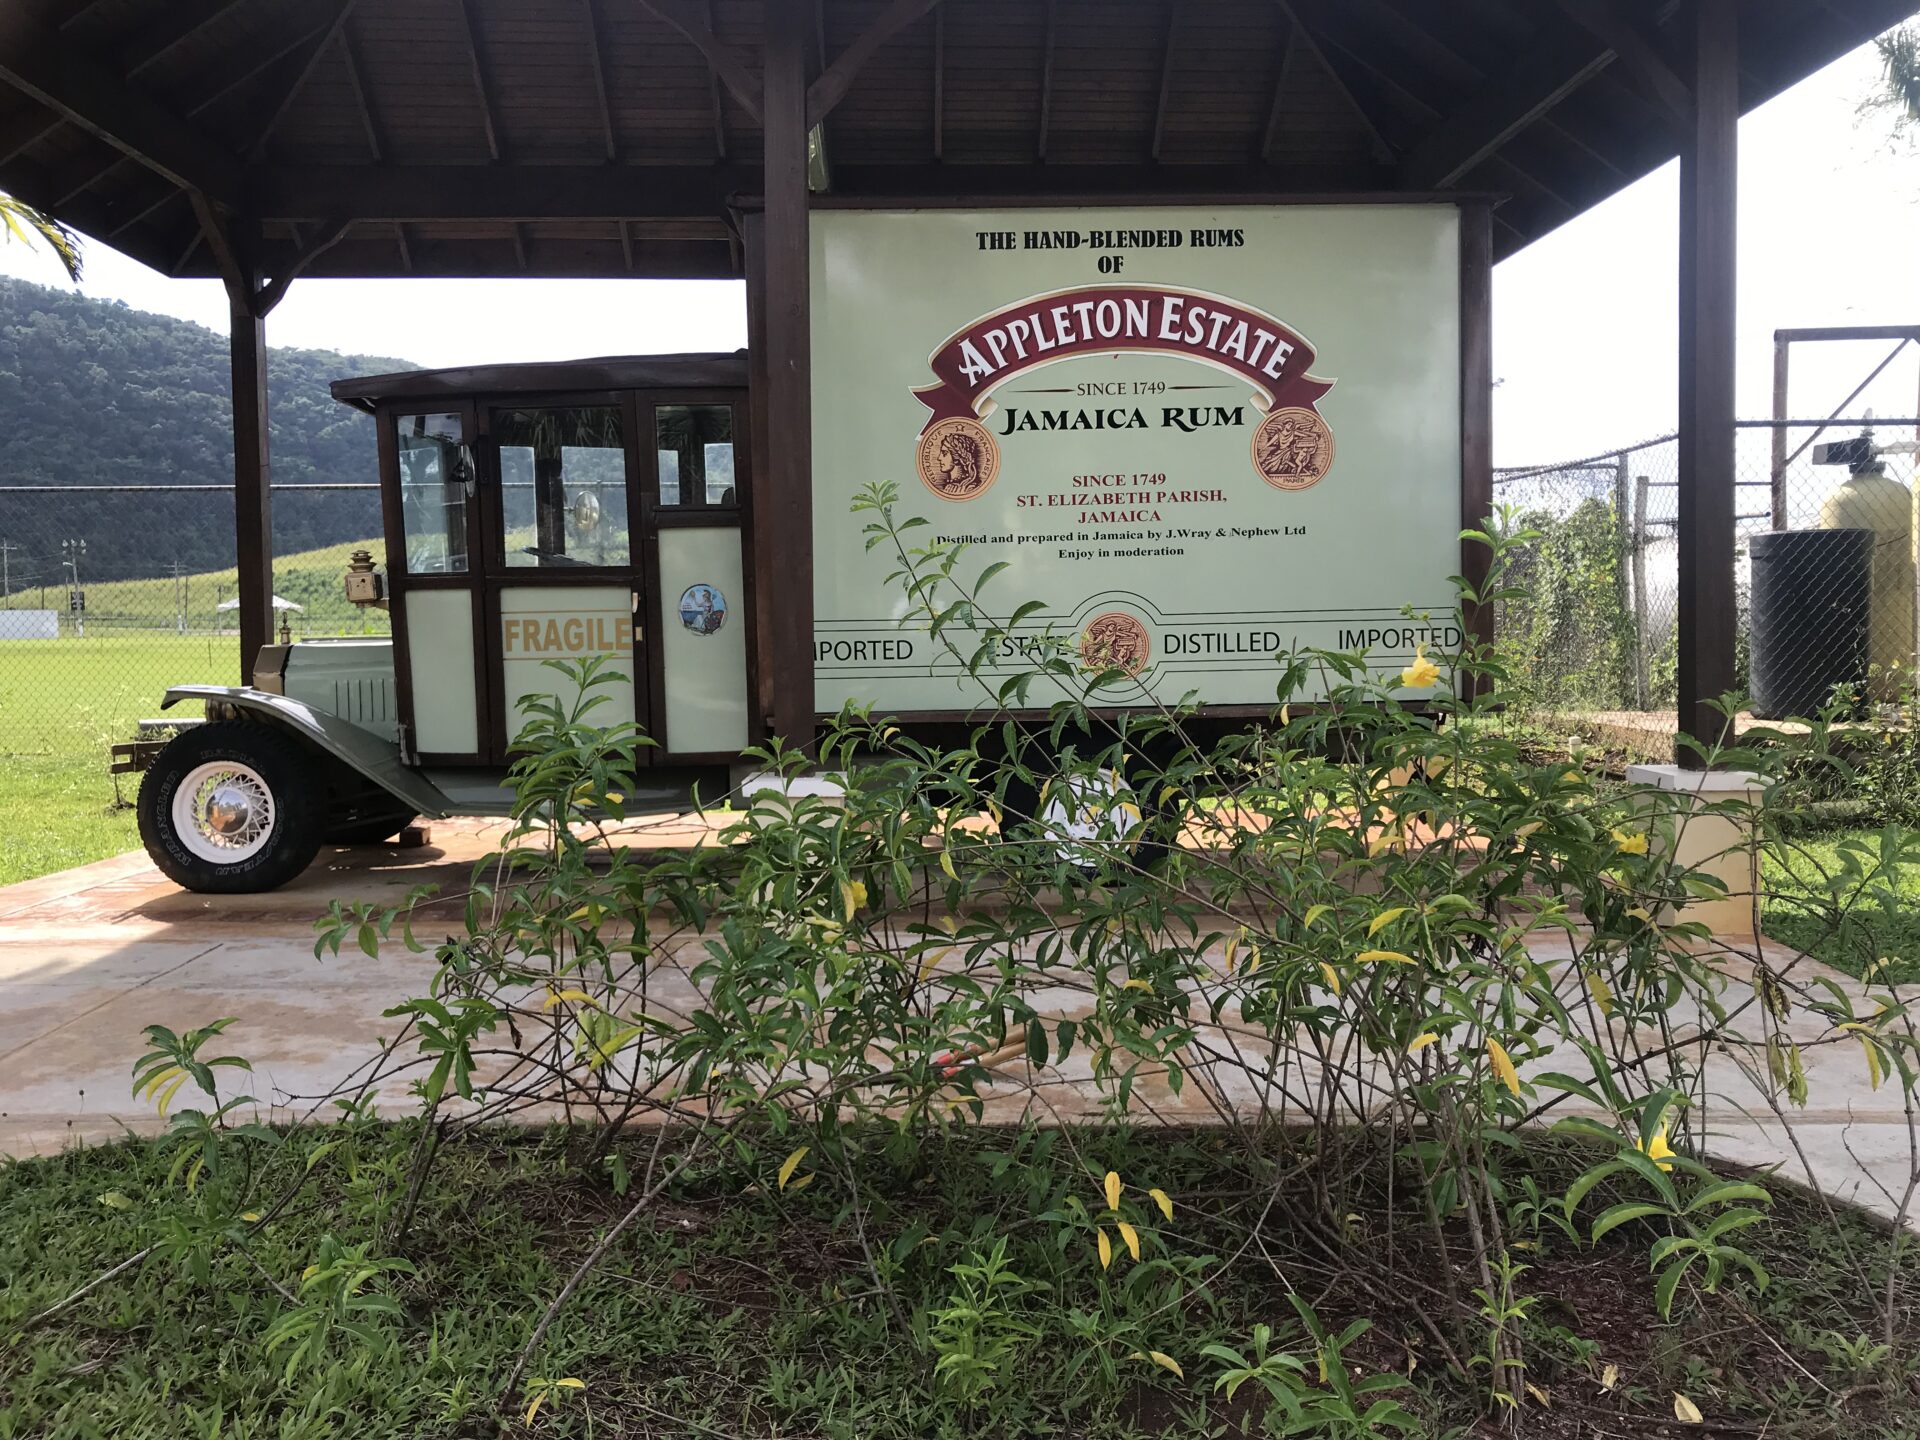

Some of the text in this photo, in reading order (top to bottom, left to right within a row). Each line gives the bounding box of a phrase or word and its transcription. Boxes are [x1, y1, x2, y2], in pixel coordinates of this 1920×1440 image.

[976, 229, 1245, 250] THE HAND-BLENDED RUMS
[1097, 256, 1124, 274] OF
[958, 296, 1295, 388] APPLETON ESTATE
[1077, 381, 1166, 396] SINCE 1749
[998, 406, 1245, 436] JAMAICA RUM
[1072, 473, 1166, 488] SINCE 1749
[1016, 489, 1228, 507] ST. ELIZABETH PARISH,
[1078, 510, 1163, 524] JAMAICA
[936, 535, 988, 545] Distilled
[990, 534, 1014, 544] and
[1017, 532, 1074, 545] prepared
[1077, 532, 1089, 541] in
[1092, 530, 1144, 541] Jamaica
[1147, 530, 1162, 541] by
[1215, 527, 1227, 537] &
[1230, 526, 1281, 539] Nephew
[1284, 525, 1307, 536] Ltd
[1058, 546, 1185, 561] Enjoy in moderation
[504, 617, 633, 652] FRAGILE
[1164, 631, 1281, 654] DISTILLED
[1339, 627, 1461, 650] IMPORTED
[813, 639, 914, 661] PORTED
